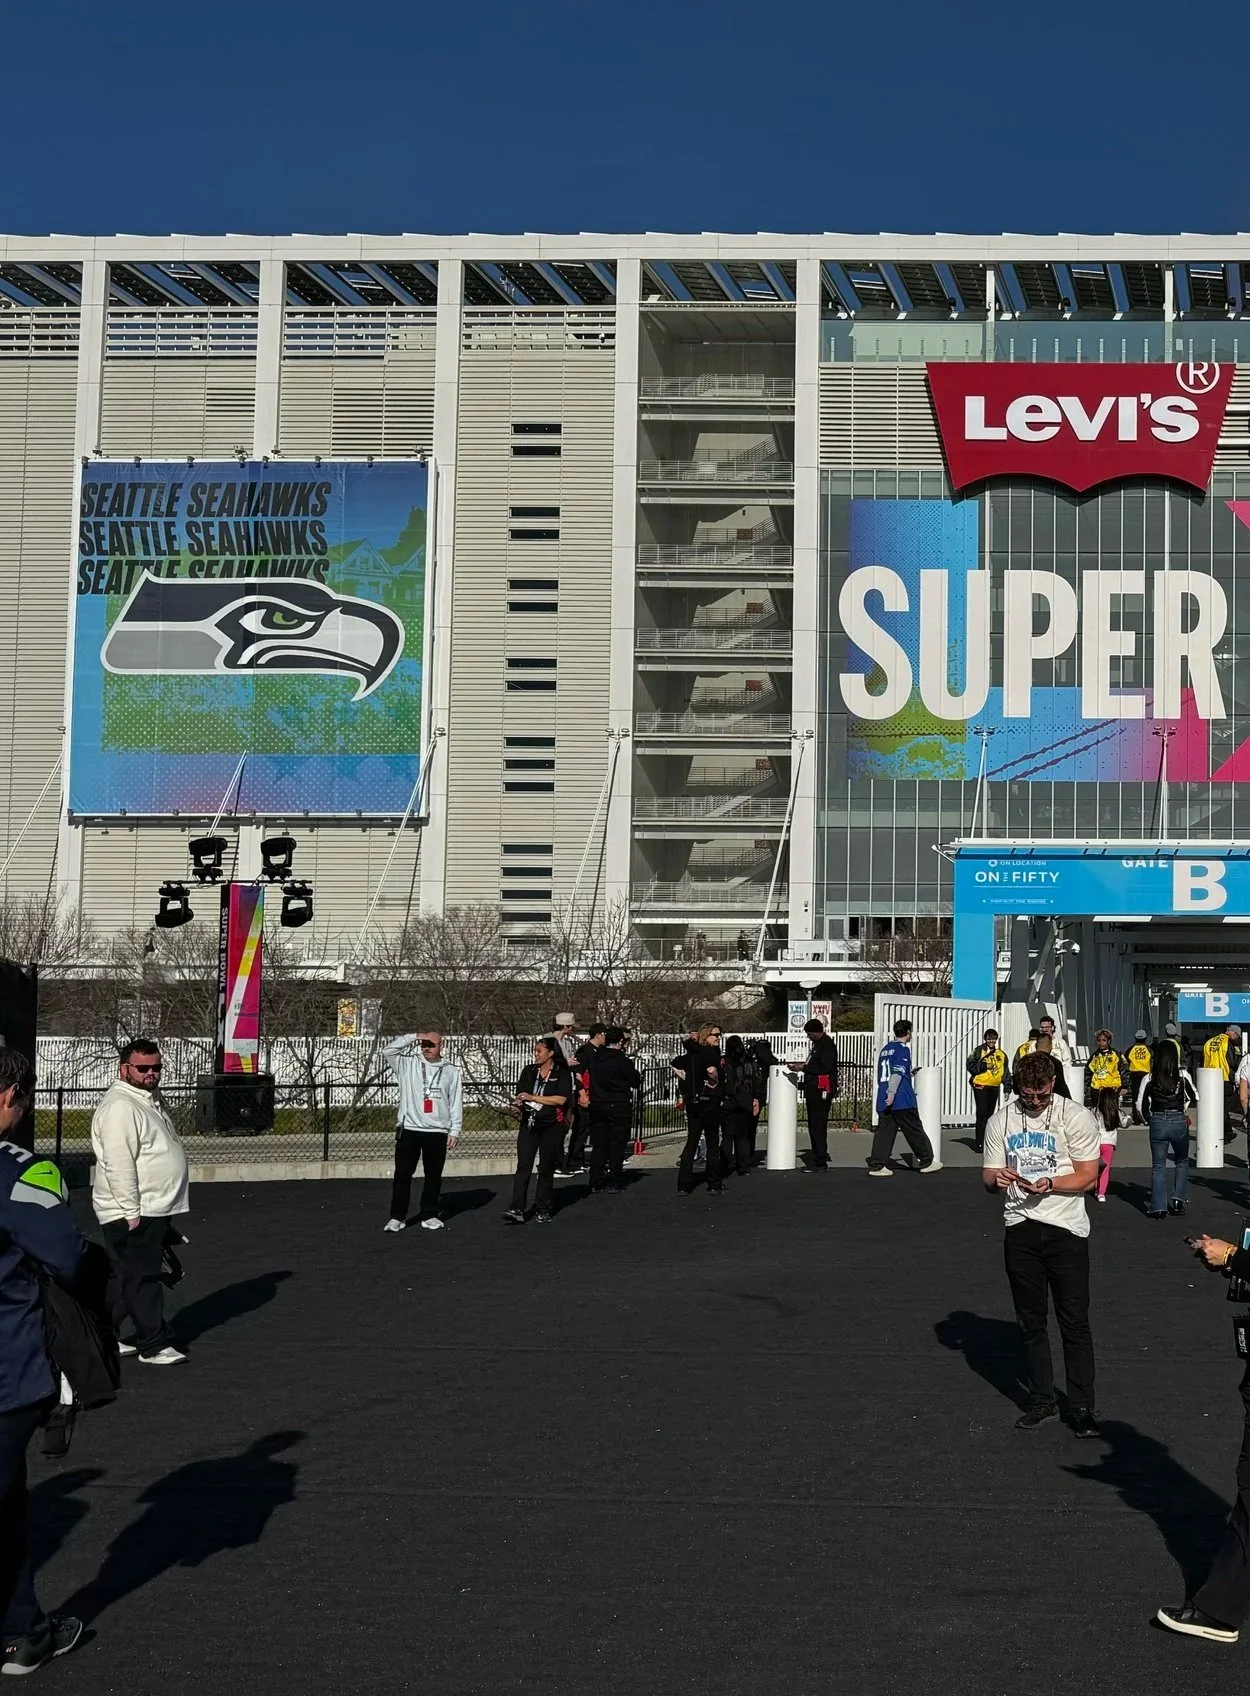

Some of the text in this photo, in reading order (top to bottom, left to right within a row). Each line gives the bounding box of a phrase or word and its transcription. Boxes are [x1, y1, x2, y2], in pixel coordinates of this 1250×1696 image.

[80, 482, 332, 518] SEATTLE SEAHAWKS
[79, 519, 328, 556] SEATTLE SEAHAWKS
[838, 566, 1228, 723] SUPER
[975, 871, 999, 883] ON
[1012, 871, 1060, 883] FIFTY
[1121, 856, 1227, 911] GATE B
[220, 908, 228, 949] SUPER
[1205, 993, 1230, 1016] B
